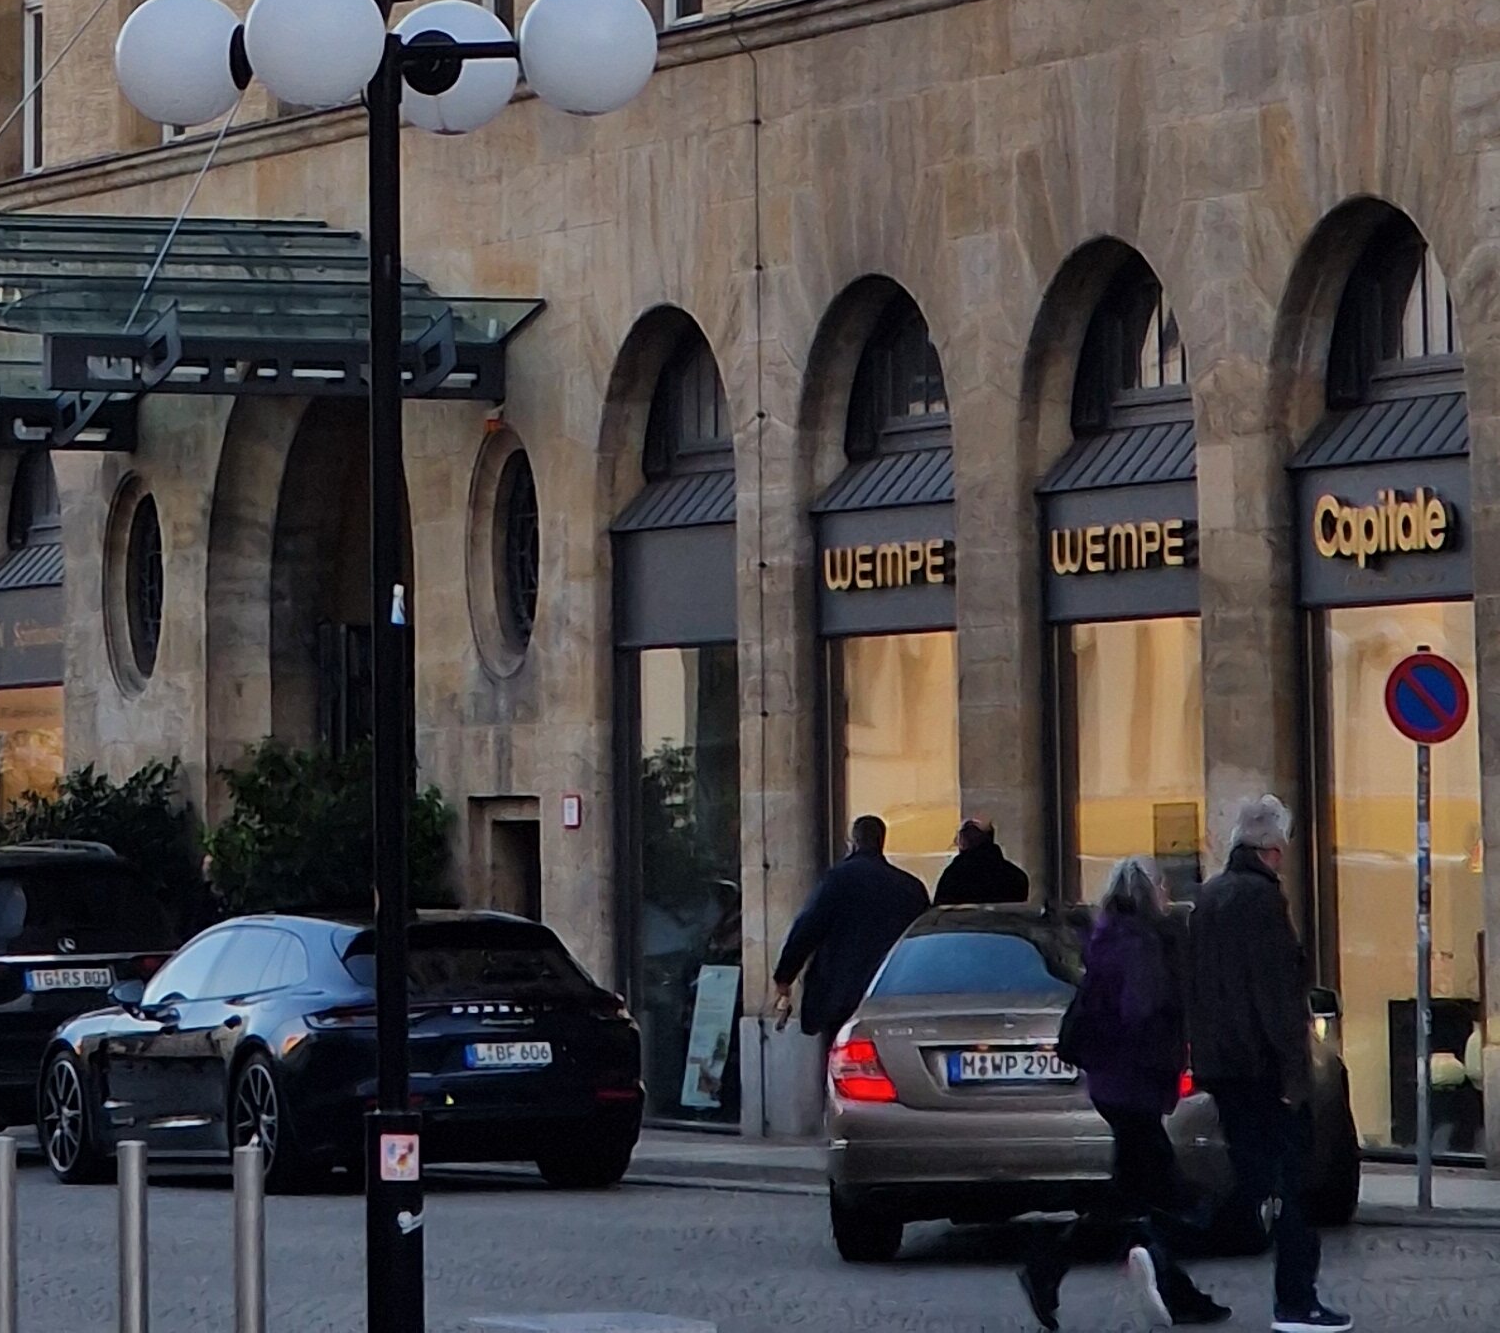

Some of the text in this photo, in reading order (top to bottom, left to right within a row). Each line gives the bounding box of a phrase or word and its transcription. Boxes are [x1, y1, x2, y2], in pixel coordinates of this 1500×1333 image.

[1051, 518, 1186, 575] WEMPE
[1313, 486, 1447, 569] Capitale
[823, 538, 946, 591] WEMPE
[519, 1044, 550, 1061] 606
